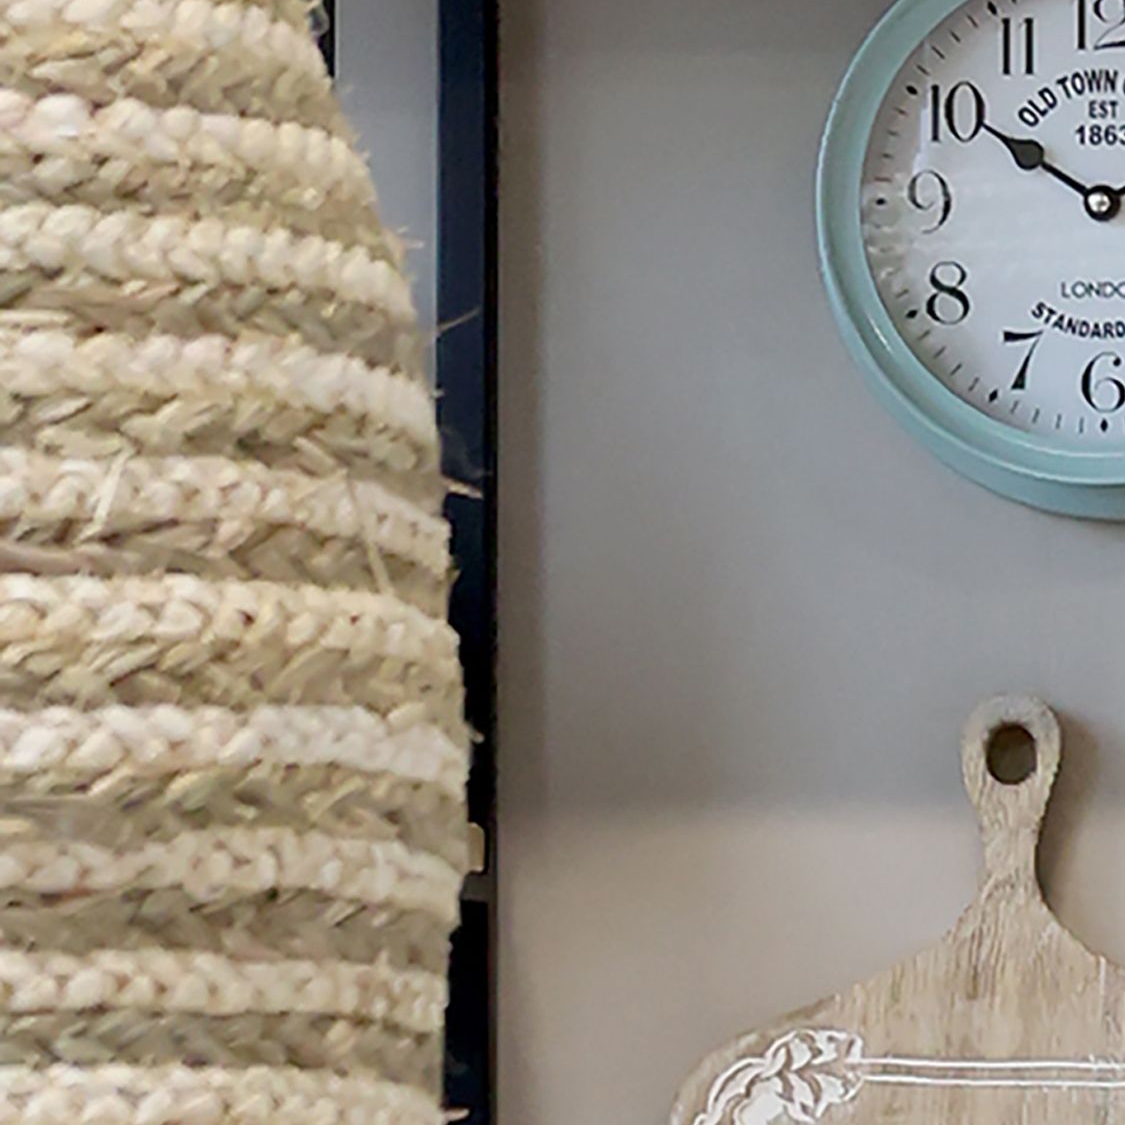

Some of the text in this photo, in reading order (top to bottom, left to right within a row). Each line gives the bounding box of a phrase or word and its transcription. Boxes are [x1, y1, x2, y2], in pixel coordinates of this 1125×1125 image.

[1001, 16, 1034, 76] 11
[930, 81, 985, 143] 10
[1017, 86, 1058, 127] OLD
[1055, 69, 1119, 100] TOWN
[1088, 100, 1119, 119] EST
[907, 169, 952, 235] 9
[925, 261, 971, 326] 8
[1002, 330, 1045, 392] 7
